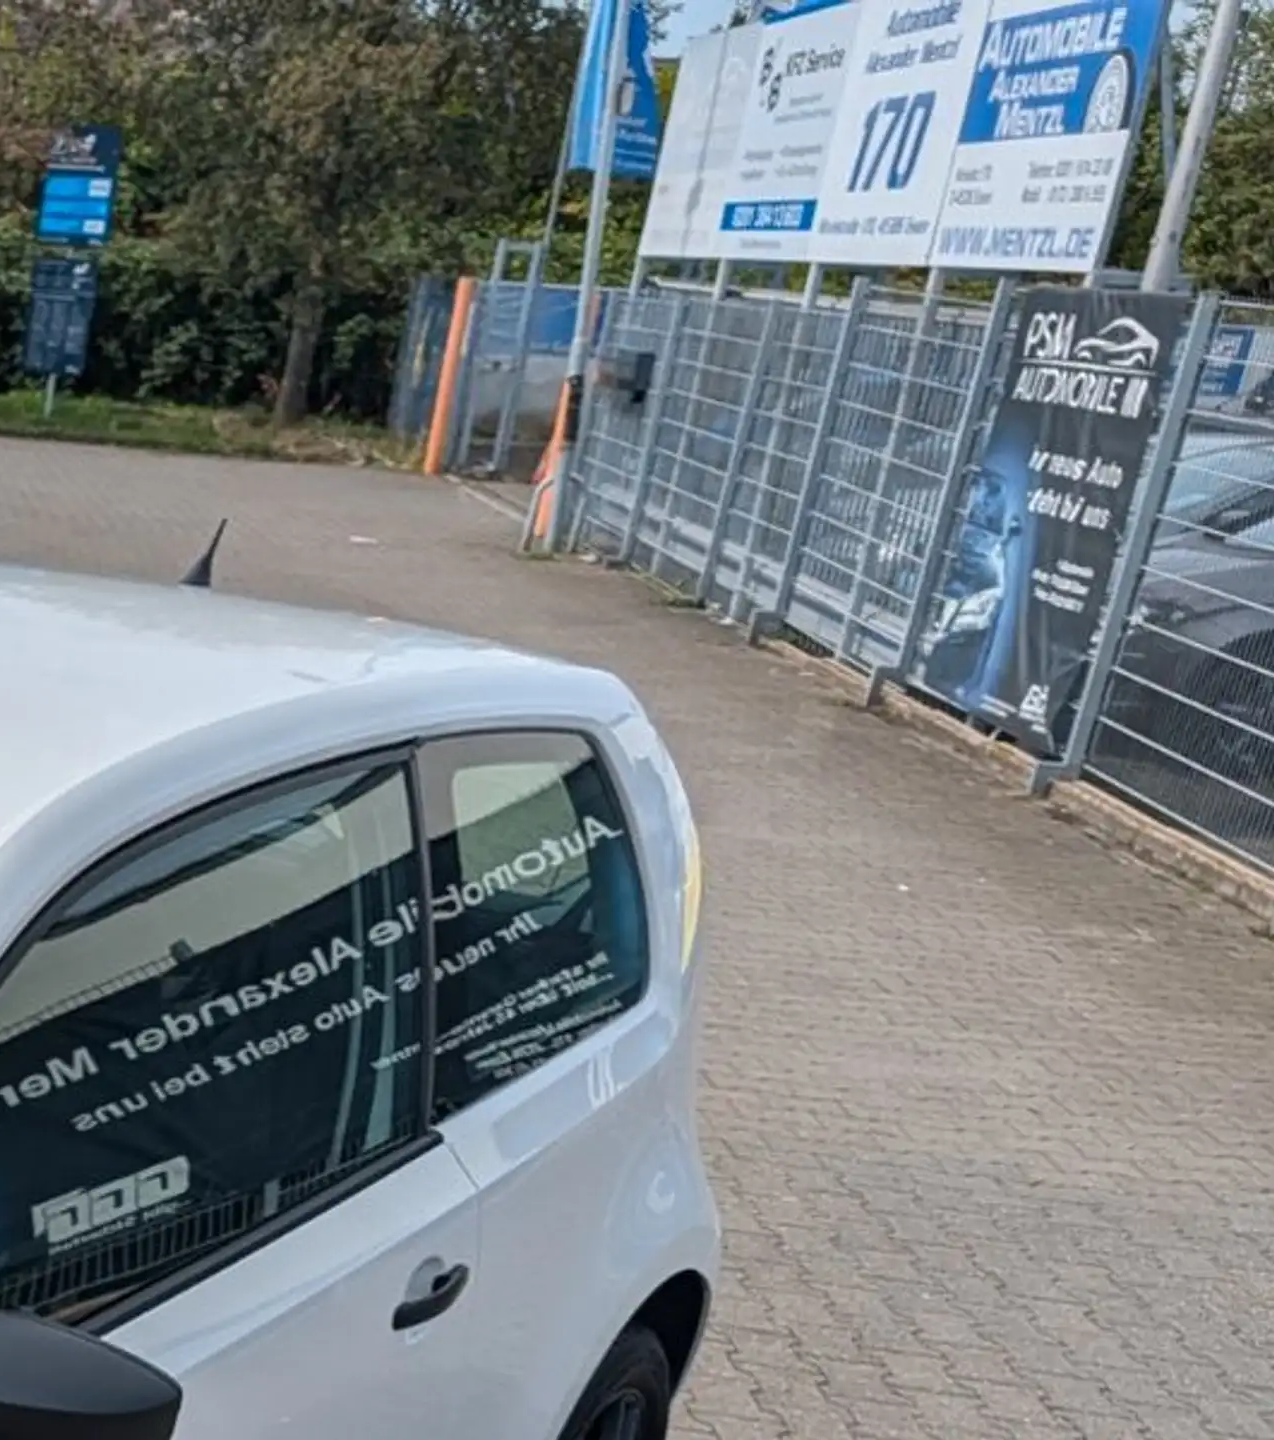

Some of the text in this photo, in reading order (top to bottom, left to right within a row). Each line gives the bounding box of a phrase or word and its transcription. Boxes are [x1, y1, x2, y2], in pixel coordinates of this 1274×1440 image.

[978, 7, 1128, 73] AUTOMOBILE
[847, 90, 937, 193] 170
[993, 101, 1065, 139] MENTZL
[1022, 311, 1077, 360] PSM
